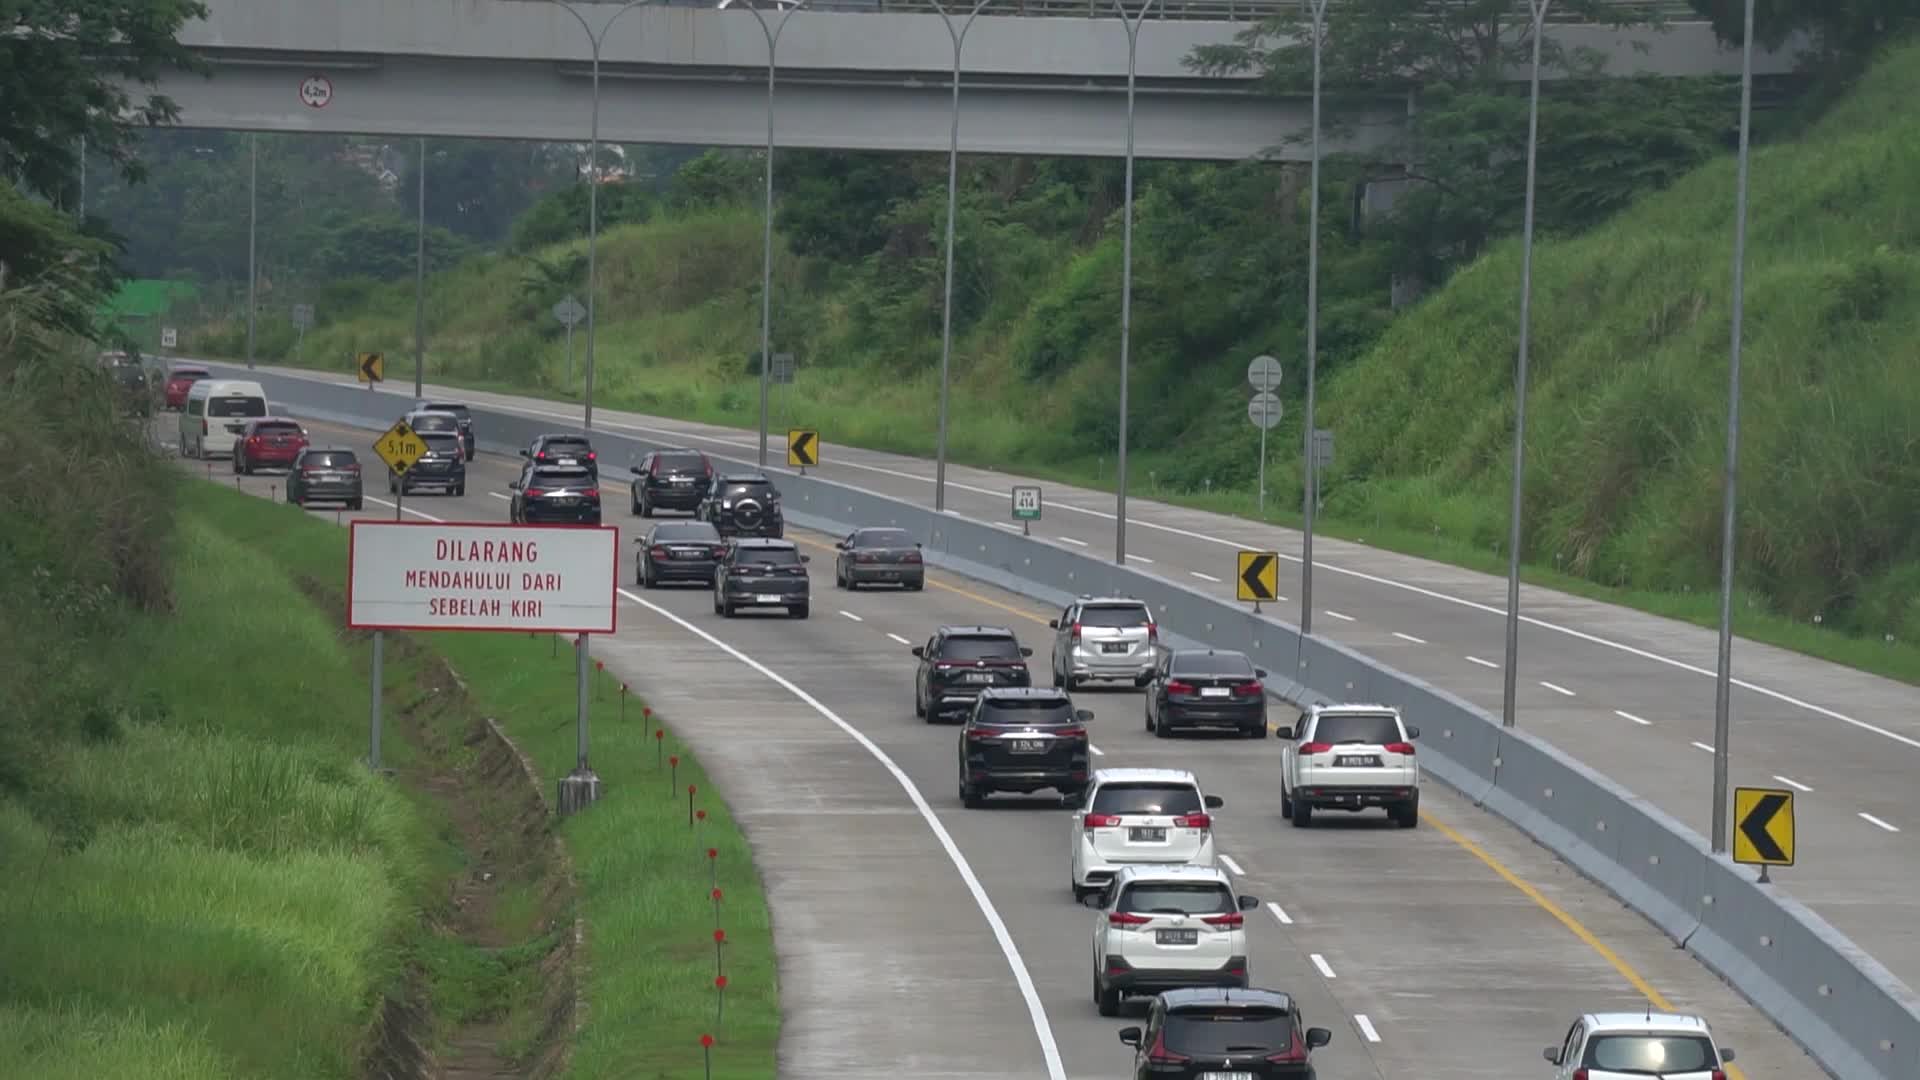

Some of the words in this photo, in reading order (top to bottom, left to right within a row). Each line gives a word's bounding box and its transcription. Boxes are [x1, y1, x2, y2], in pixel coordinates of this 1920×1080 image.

[1019, 497, 1034, 508] 414
[436, 539, 537, 562] DILARANG
[406, 570, 510, 590] MENDAHULUI
[523, 573, 561, 591] DARI
[429, 598, 500, 616] SEBELAH
[512, 600, 542, 618] KIRI
